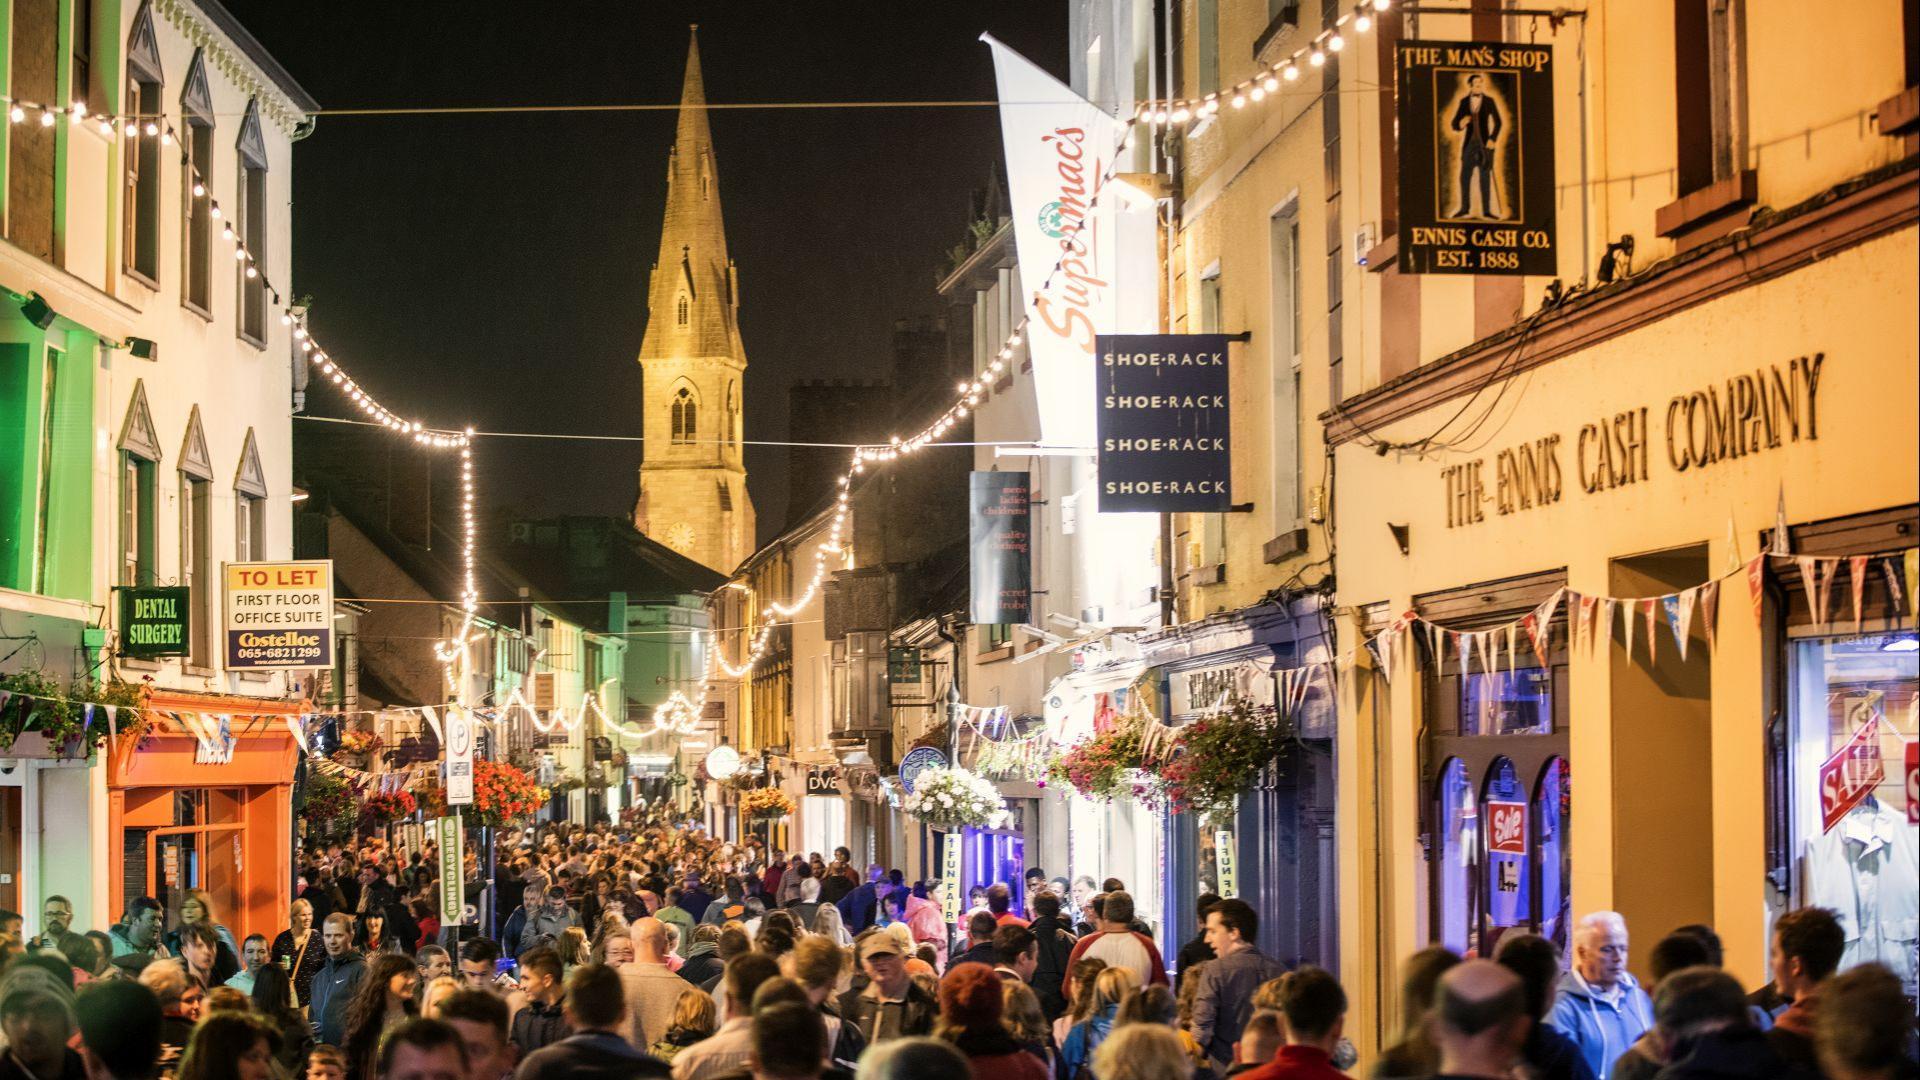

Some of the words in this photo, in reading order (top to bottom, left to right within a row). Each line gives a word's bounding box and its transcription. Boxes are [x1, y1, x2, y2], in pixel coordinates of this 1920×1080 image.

[1403, 47, 1441, 68] THE
[1447, 46, 1495, 67] MAN'S
[1499, 49, 1550, 72] SHOP
[1411, 227, 1467, 246] ENNIS
[1471, 229, 1518, 247] CASH
[1522, 230, 1550, 249] CO.
[1436, 250, 1474, 268] EST.
[1479, 251, 1520, 269] 1888
[1440, 458, 1485, 529] THE
[1496, 433, 1562, 516] ENNIS
[1577, 406, 1649, 495] CASH
[1666, 352, 1825, 473] COMPANY
[238, 571, 268, 586] TO
[277, 570, 318, 586] LET
[134, 598, 178, 619] DENTAL
[236, 594, 272, 606] FIRST
[276, 594, 321, 605] FLOOR
[234, 612, 281, 624] OFFICE
[285, 611, 323, 623] SUITE
[129, 623, 182, 645] SURGERY
[238, 631, 321, 648] Costelloe
[1823, 728, 1881, 817] SALE
[1494, 806, 1522, 844] Sale
[946, 851, 956, 878] FUN
[945, 883, 955, 919] FAIR
